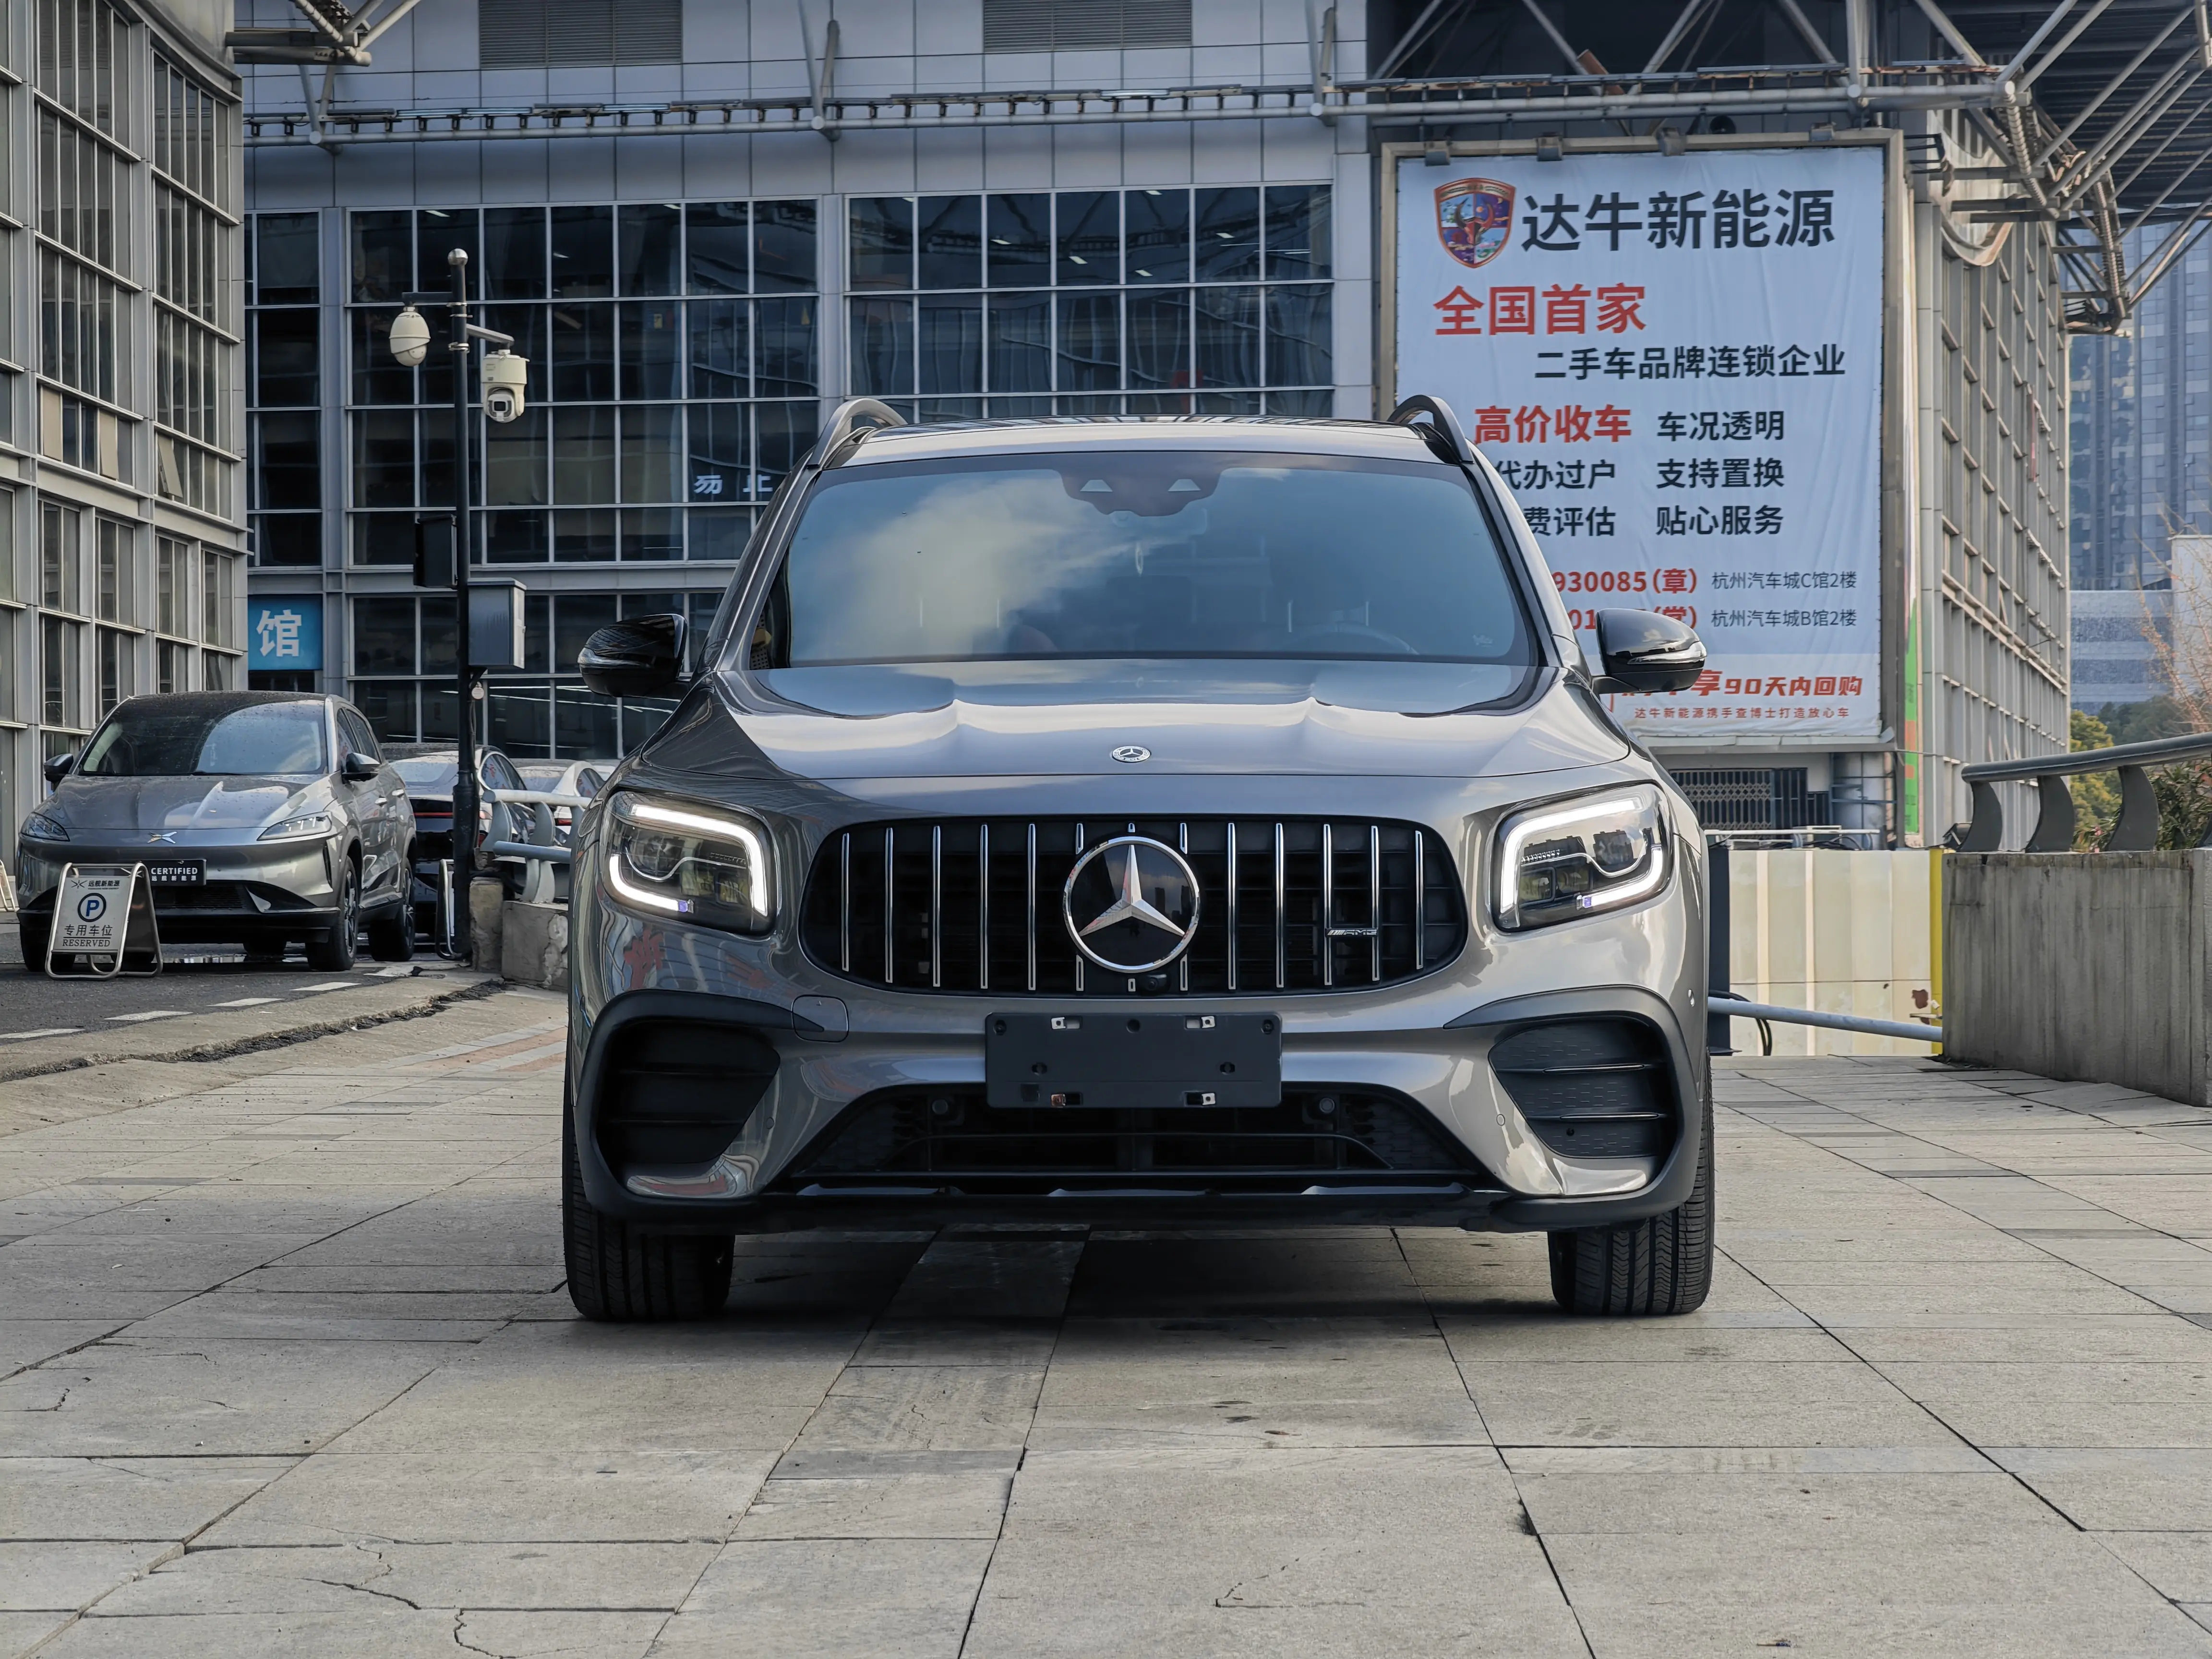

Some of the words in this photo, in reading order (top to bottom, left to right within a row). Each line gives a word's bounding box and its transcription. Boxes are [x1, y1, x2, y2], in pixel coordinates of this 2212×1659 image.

[1521, 188, 1835, 252] 达牛新能源
[1433, 282, 1646, 336] 全国首家
[1535, 343, 1846, 381] 二手车品牌连锁企业
[1474, 405, 1632, 444] 高价收车
[1657, 410, 1785, 442] 车况透明
[1495, 459, 1616, 490] 代办过户
[1656, 457, 1784, 489] 支持置换
[1656, 505, 1784, 536] 贴心服务
[1711, 571, 1857, 589] 杭州汽车城C馆2楼
[256, 609, 301, 657] 馆
[1711, 609, 1857, 627] 杭州汽车城B馆2楼
[62, 939, 110, 947] RESERVED
[64, 924, 113, 937] 专用车位
